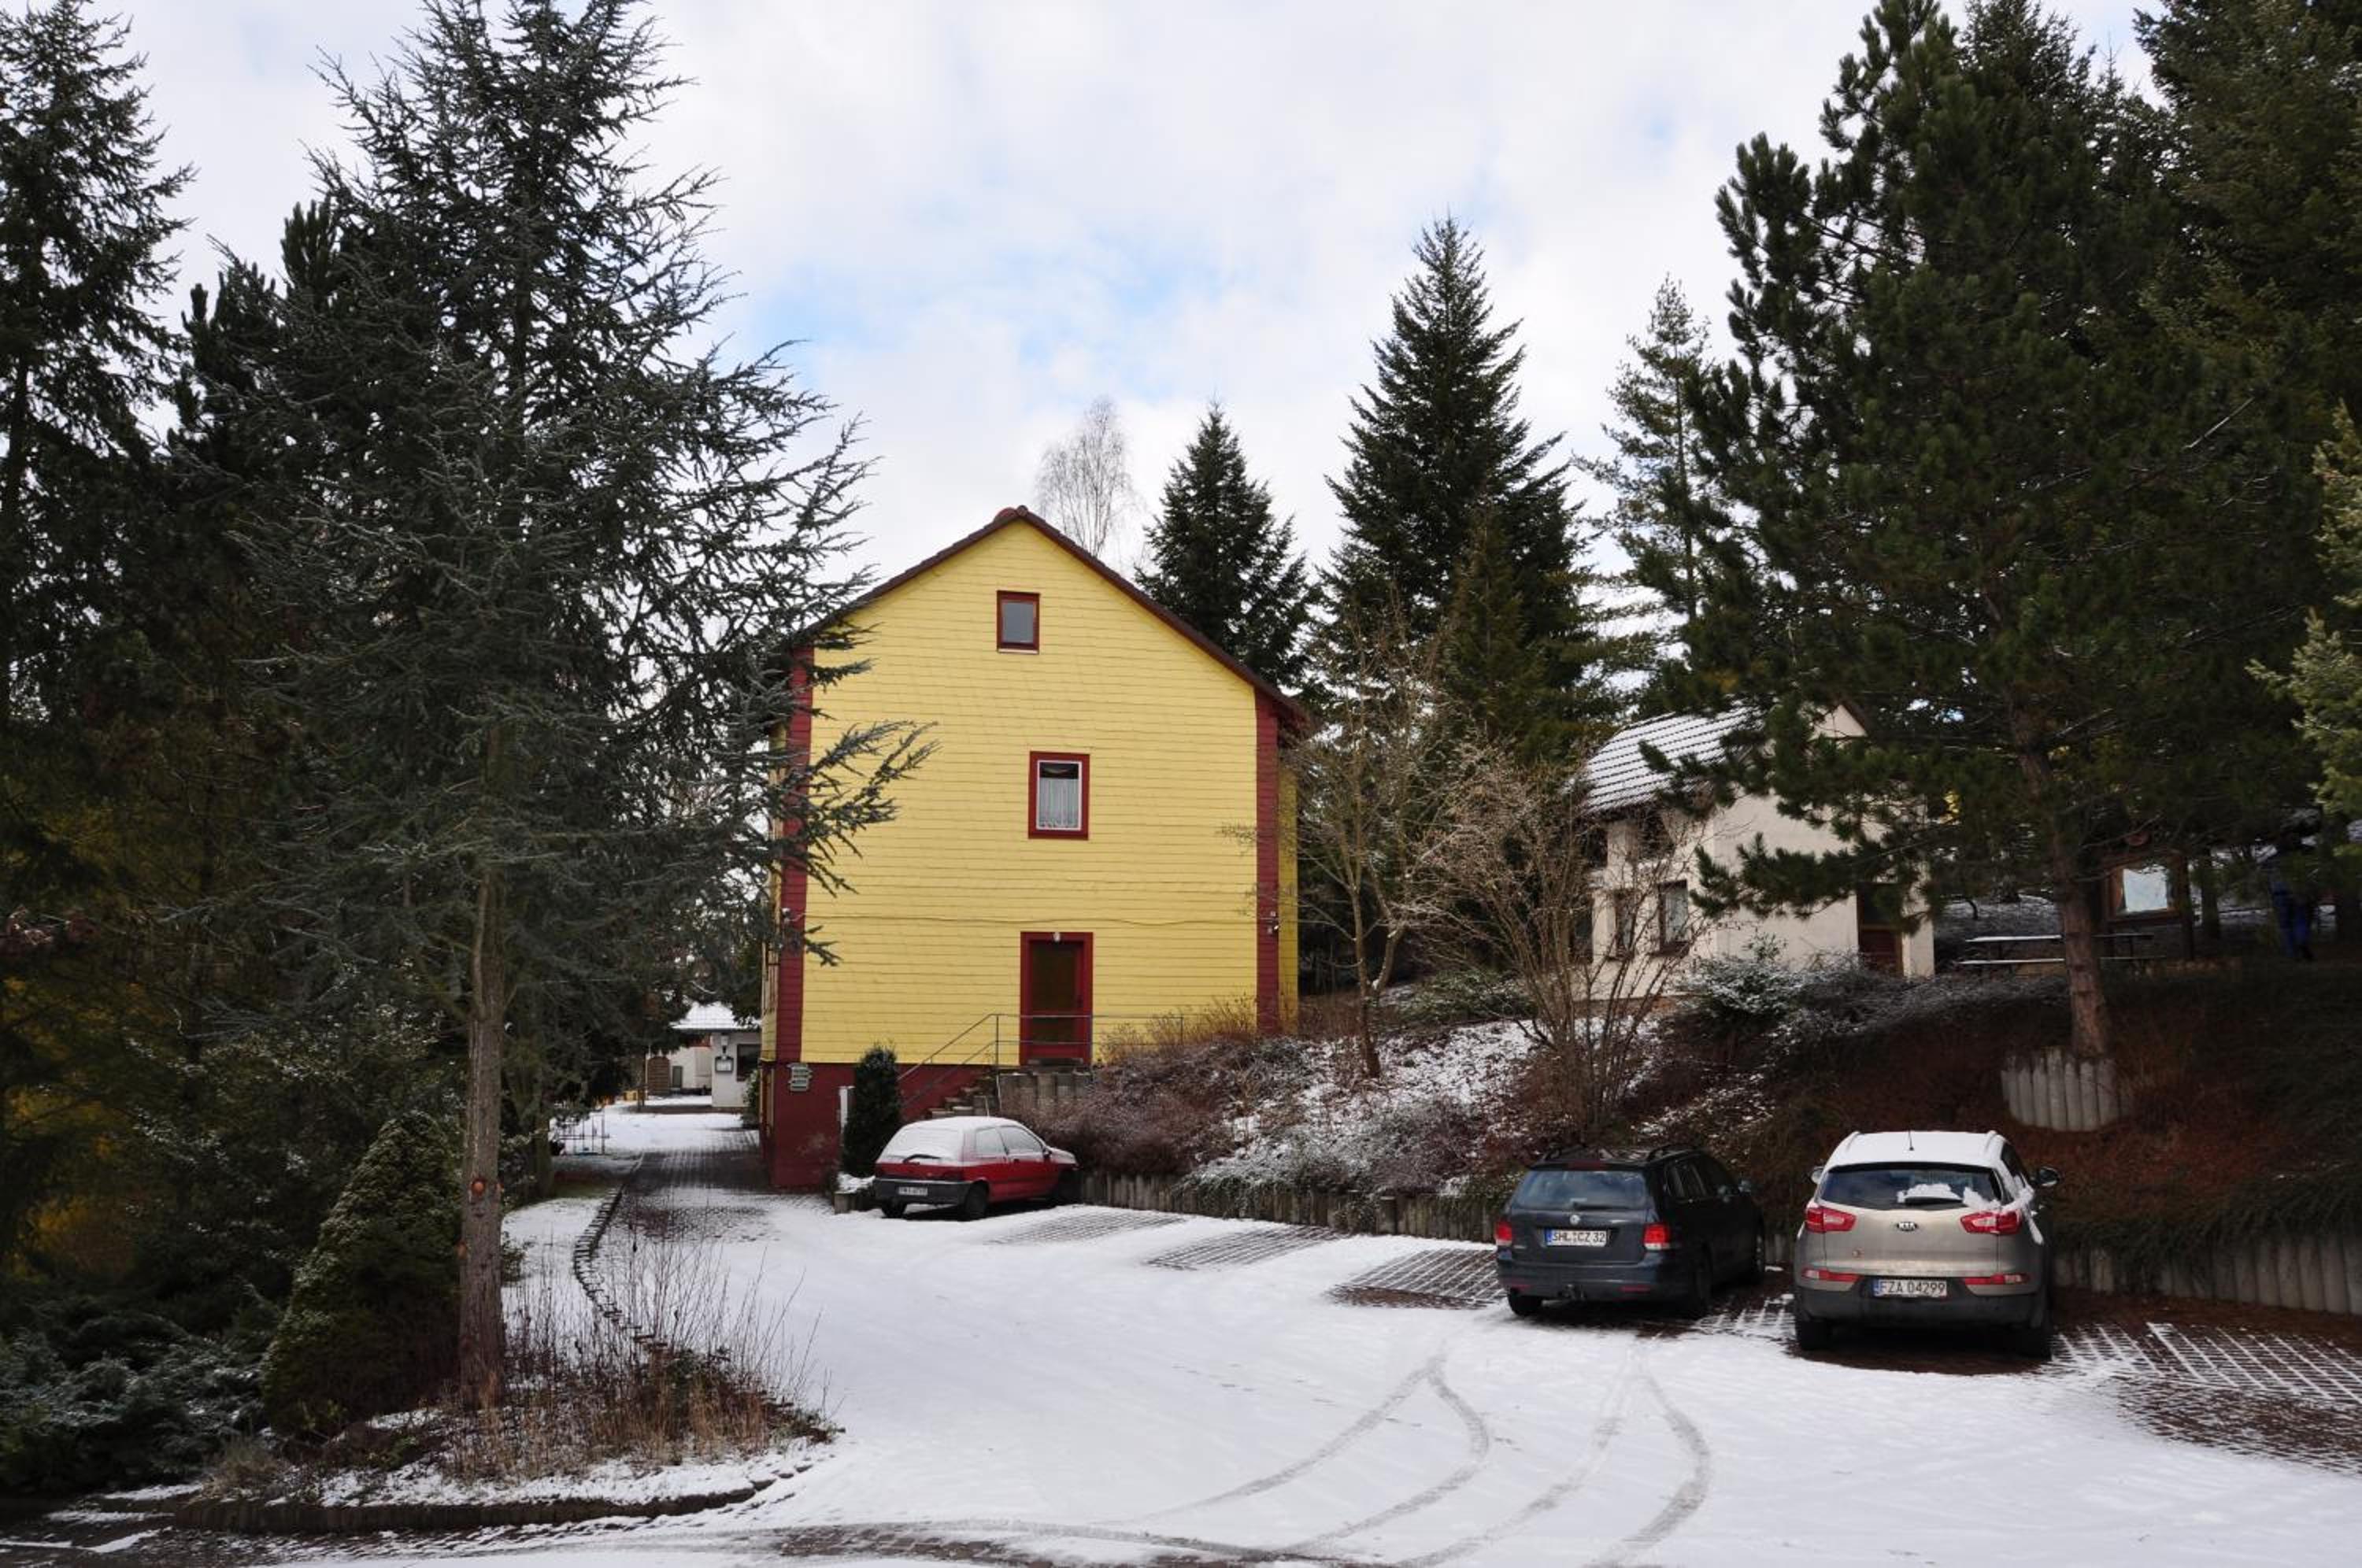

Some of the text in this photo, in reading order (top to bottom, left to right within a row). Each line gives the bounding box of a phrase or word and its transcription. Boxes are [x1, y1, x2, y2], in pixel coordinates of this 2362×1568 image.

[1593, 1232, 1605, 1243] 32
[1879, 1281, 1946, 1294] FZA 04299
